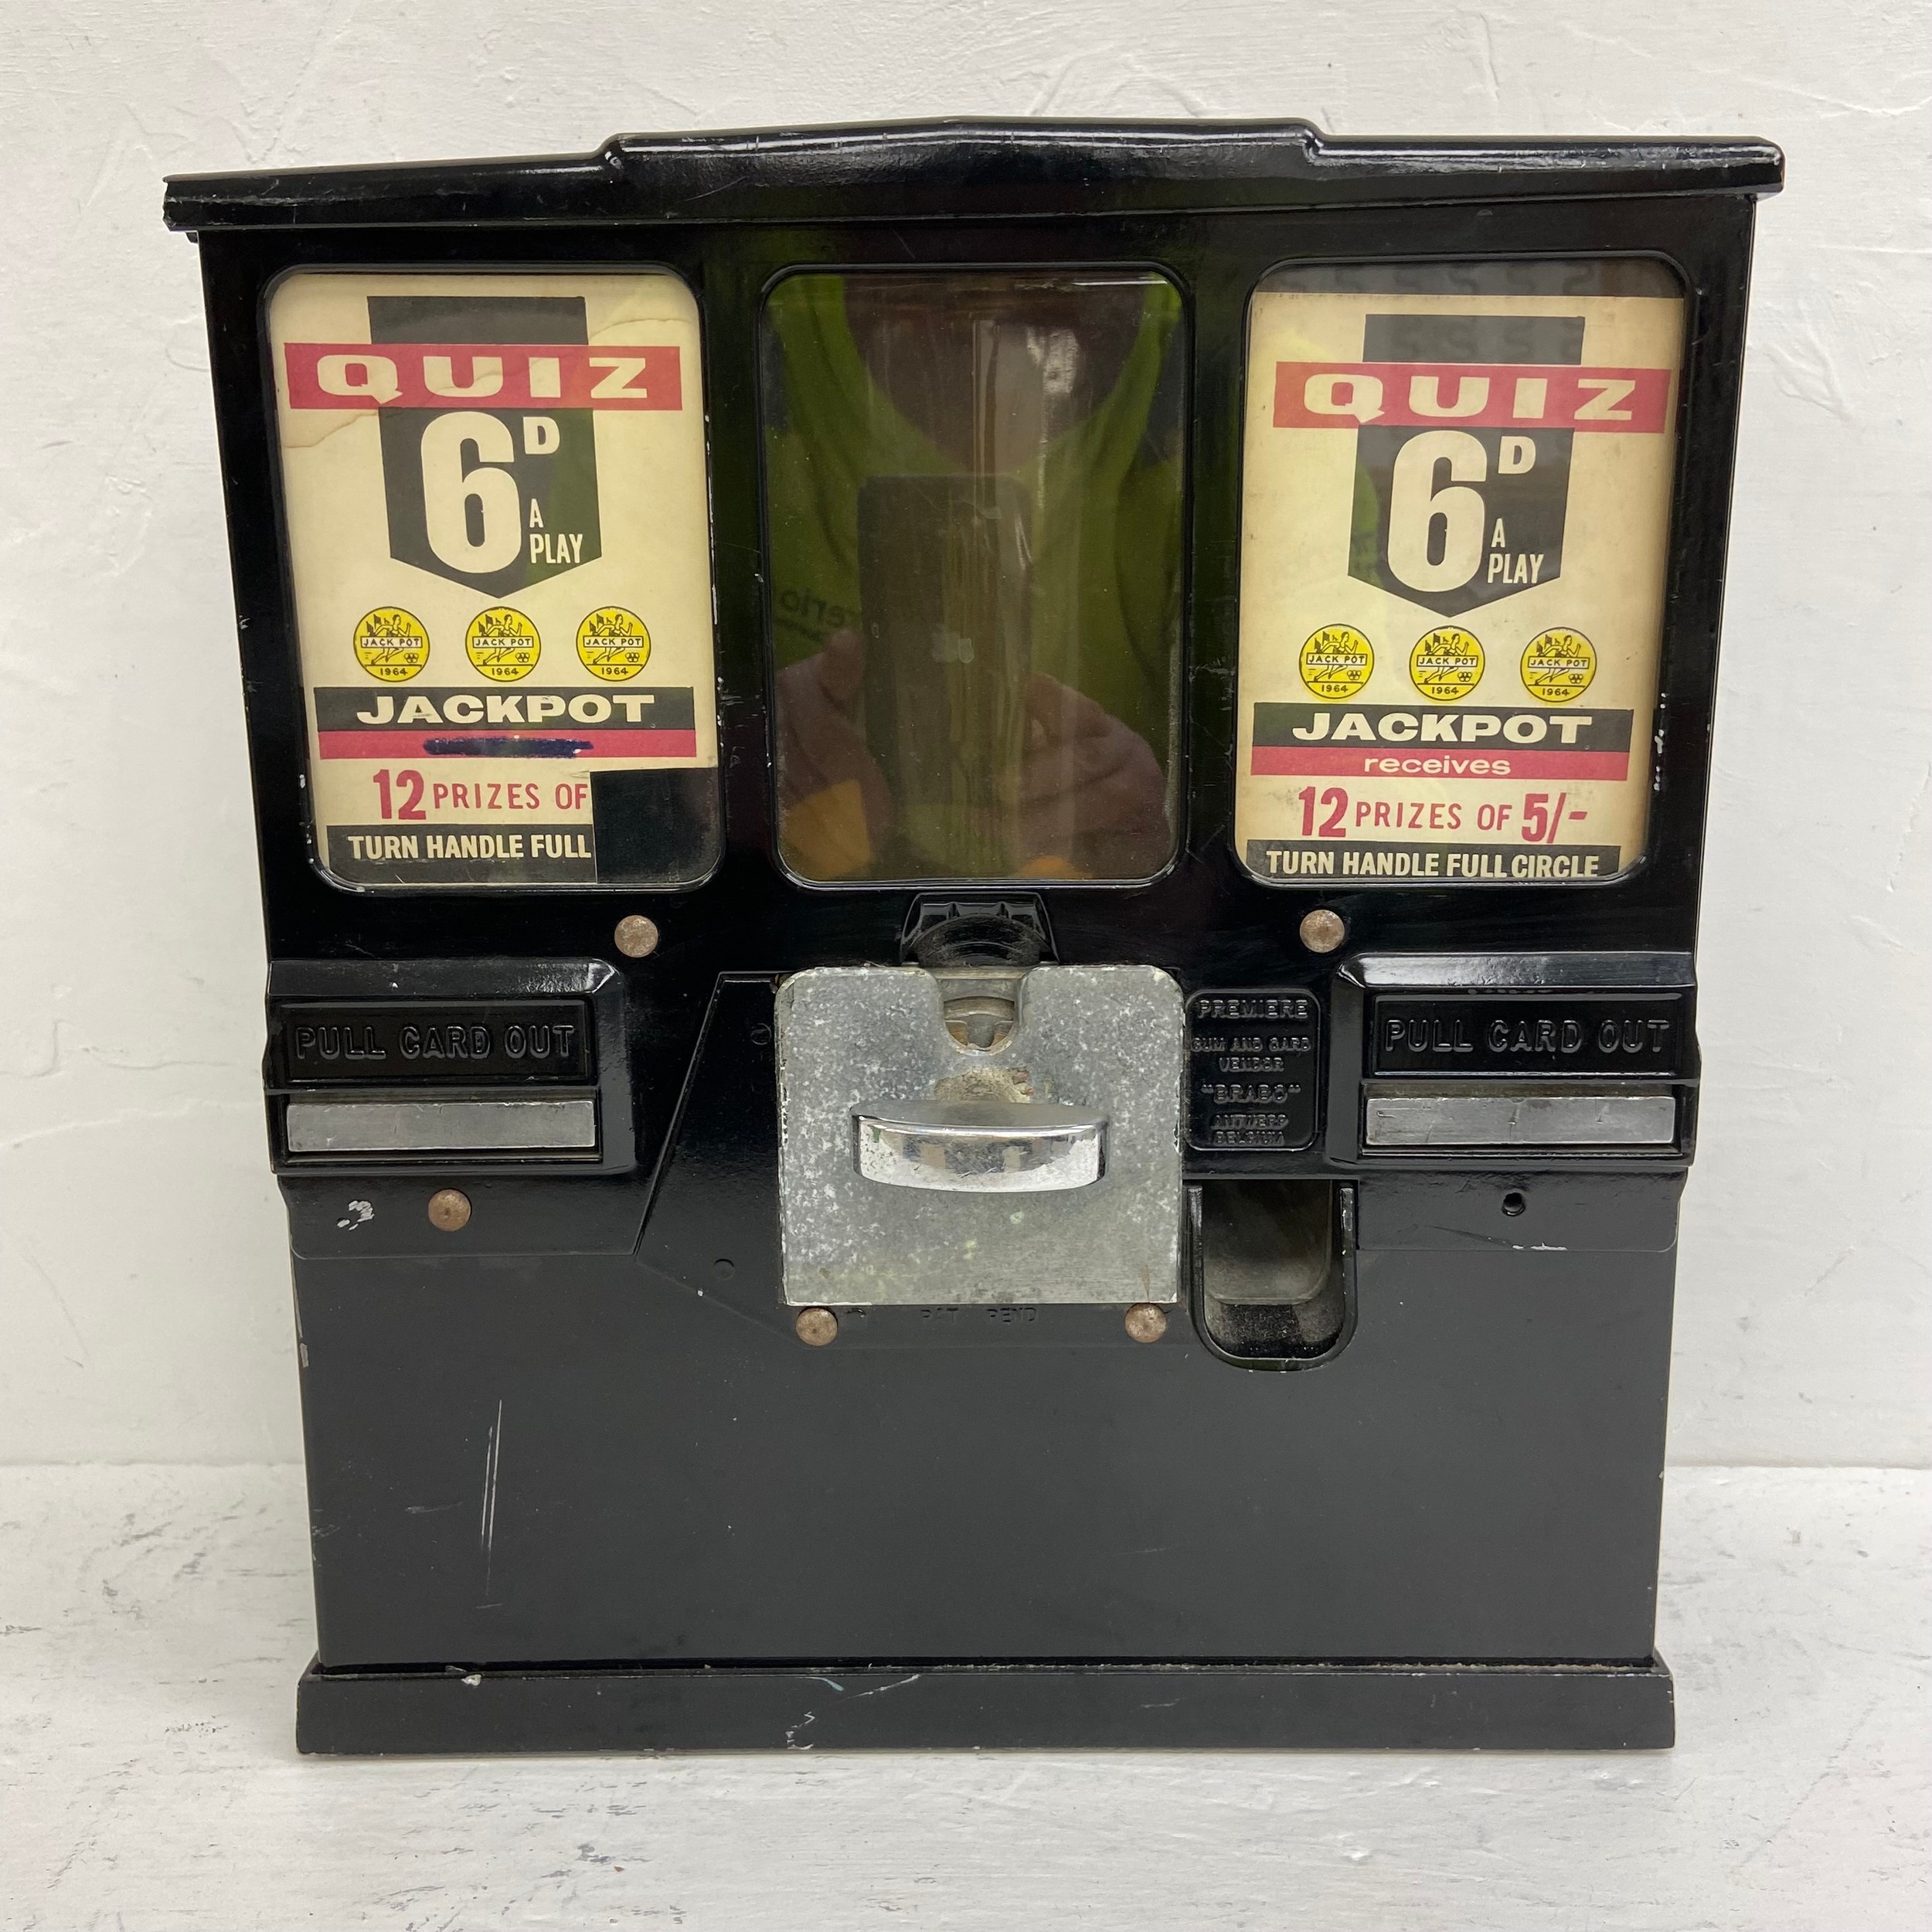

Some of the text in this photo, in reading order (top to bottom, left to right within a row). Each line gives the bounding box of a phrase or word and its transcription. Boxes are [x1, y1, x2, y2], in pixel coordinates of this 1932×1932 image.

[317, 354, 648, 405] QUIZ
[1304, 373, 1635, 424] QUIZ
[529, 498, 543, 528] A
[1491, 518, 1505, 548] A
[529, 533, 583, 563] PLAY
[1487, 553, 1544, 584] PLAY
[363, 638, 394, 647] JACK
[472, 638, 534, 648] JACK POT
[585, 638, 642, 647] JACK POT
[491, 667, 519, 675] 1964
[600, 667, 628, 675] 1964
[1308, 655, 1366, 665] JACK POT
[1417, 656, 1478, 666] JACK POT
[1320, 684, 1349, 693] 1964
[1430, 686, 1459, 696] 1964
[356, 695, 655, 724] JACKPOT
[1292, 713, 1593, 744] JACKPOT
[1364, 755, 1512, 775] receives
[372, 769, 589, 820] 12 PRIZES OF
[1298, 786, 1587, 844] 12 PRIZES OF 5/-
[348, 834, 591, 859] TURN HANDLE FULL
[1266, 851, 1599, 878] TURN HANDLE FULL CIRCLE
[1198, 999, 1308, 1019] PREMIERE
[295, 1024, 575, 1060] PULL CARD OUT
[1230, 1037, 1263, 1052] AND
[1385, 1019, 1670, 1053] PULL CARD OUT
